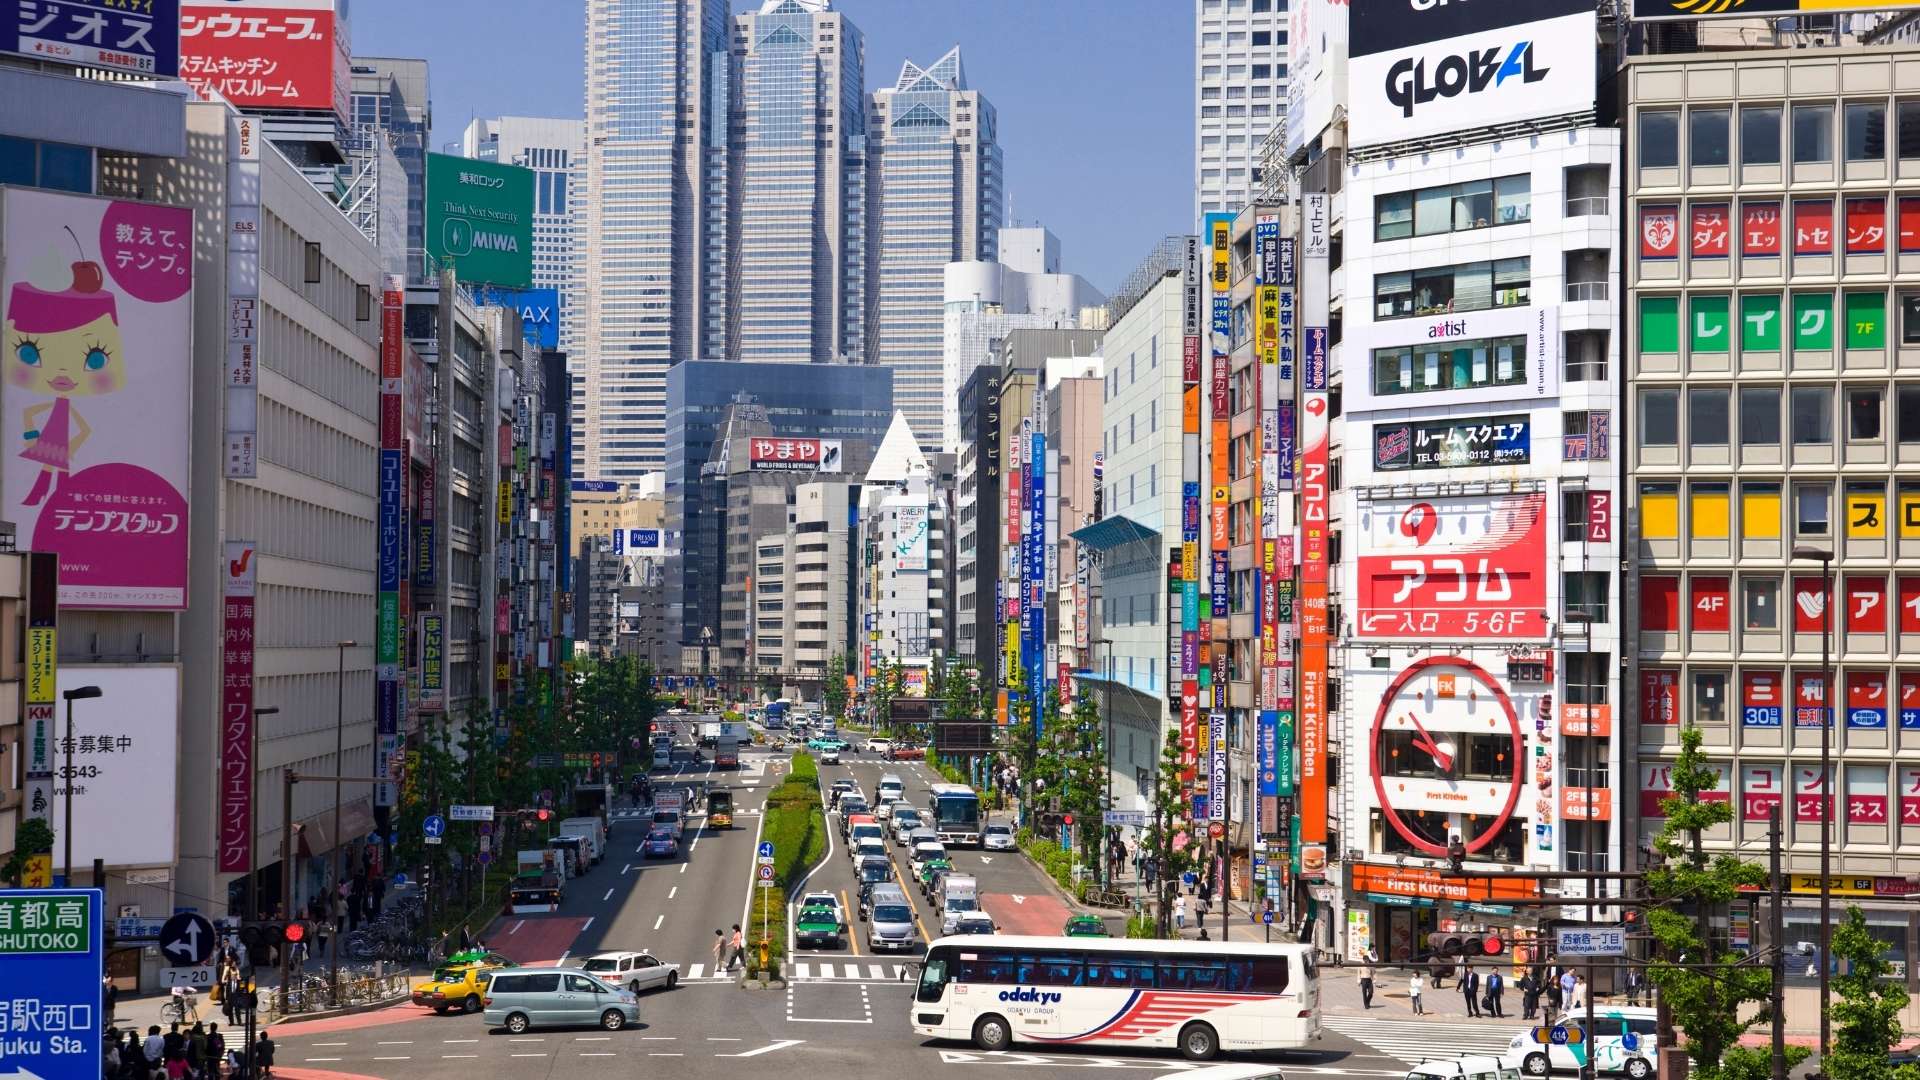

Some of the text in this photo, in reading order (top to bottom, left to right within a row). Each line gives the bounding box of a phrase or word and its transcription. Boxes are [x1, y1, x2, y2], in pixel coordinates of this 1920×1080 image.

[19, 1, 155, 53] ジオス
[181, 78, 299, 98] テムバスルーム
[240, 119, 251, 156] 久保ビル
[459, 171, 505, 189] 美和ロック
[444, 200, 518, 224] Think Next Security
[1311, 196, 1323, 247] 村上ビル
[1695, 209, 1776, 226] ミス パリ
[235, 221, 253, 230] ELS
[116, 223, 186, 250] 教えて、
[473, 231, 518, 252] MIWA
[116, 250, 186, 275] テンプ。
[1265, 241, 1276, 284] 甲新ビル
[1280, 241, 1292, 284] 共新ビル
[1215, 299, 1228, 307] DVD
[519, 305, 550, 323] AX
[1697, 309, 1826, 338] レイク
[1856, 322, 1875, 335] 7F
[1215, 358, 1226, 409] 銀座カラー
[987, 377, 999, 477] ホウライビル
[755, 440, 816, 460] やまや
[1417, 452, 1433, 462] TEL
[1566, 438, 1587, 457] 7F
[1306, 464, 1325, 521] アコム
[55, 509, 179, 535] テンプスタッフ
[1592, 495, 1607, 539] アコム
[61, 563, 90, 572] www
[1390, 558, 1512, 604] アコム
[1697, 596, 1724, 612] 4F
[1398, 612, 1440, 633] 入口
[425, 617, 442, 688] まんが喫茶
[1438, 681, 1454, 691] FK
[28, 706, 51, 719] KM
[1304, 671, 1317, 777] First Kitchen
[1184, 708, 1196, 766] アイフル
[1215, 716, 1226, 817] Mac PC Collection
[1426, 792, 1443, 801] First
[1387, 879, 1468, 896] First Kitchen
[1801, 878, 1844, 889] プロス
[0, 901, 83, 930] 首都高
[0, 932, 79, 951] HUTOKO
[1562, 933, 1619, 945] 西新宿一丁目
[998, 987, 1062, 1006] odakyu
[50, 1036, 88, 1054] Sta.
[1552, 1030, 1566, 1041] 414
